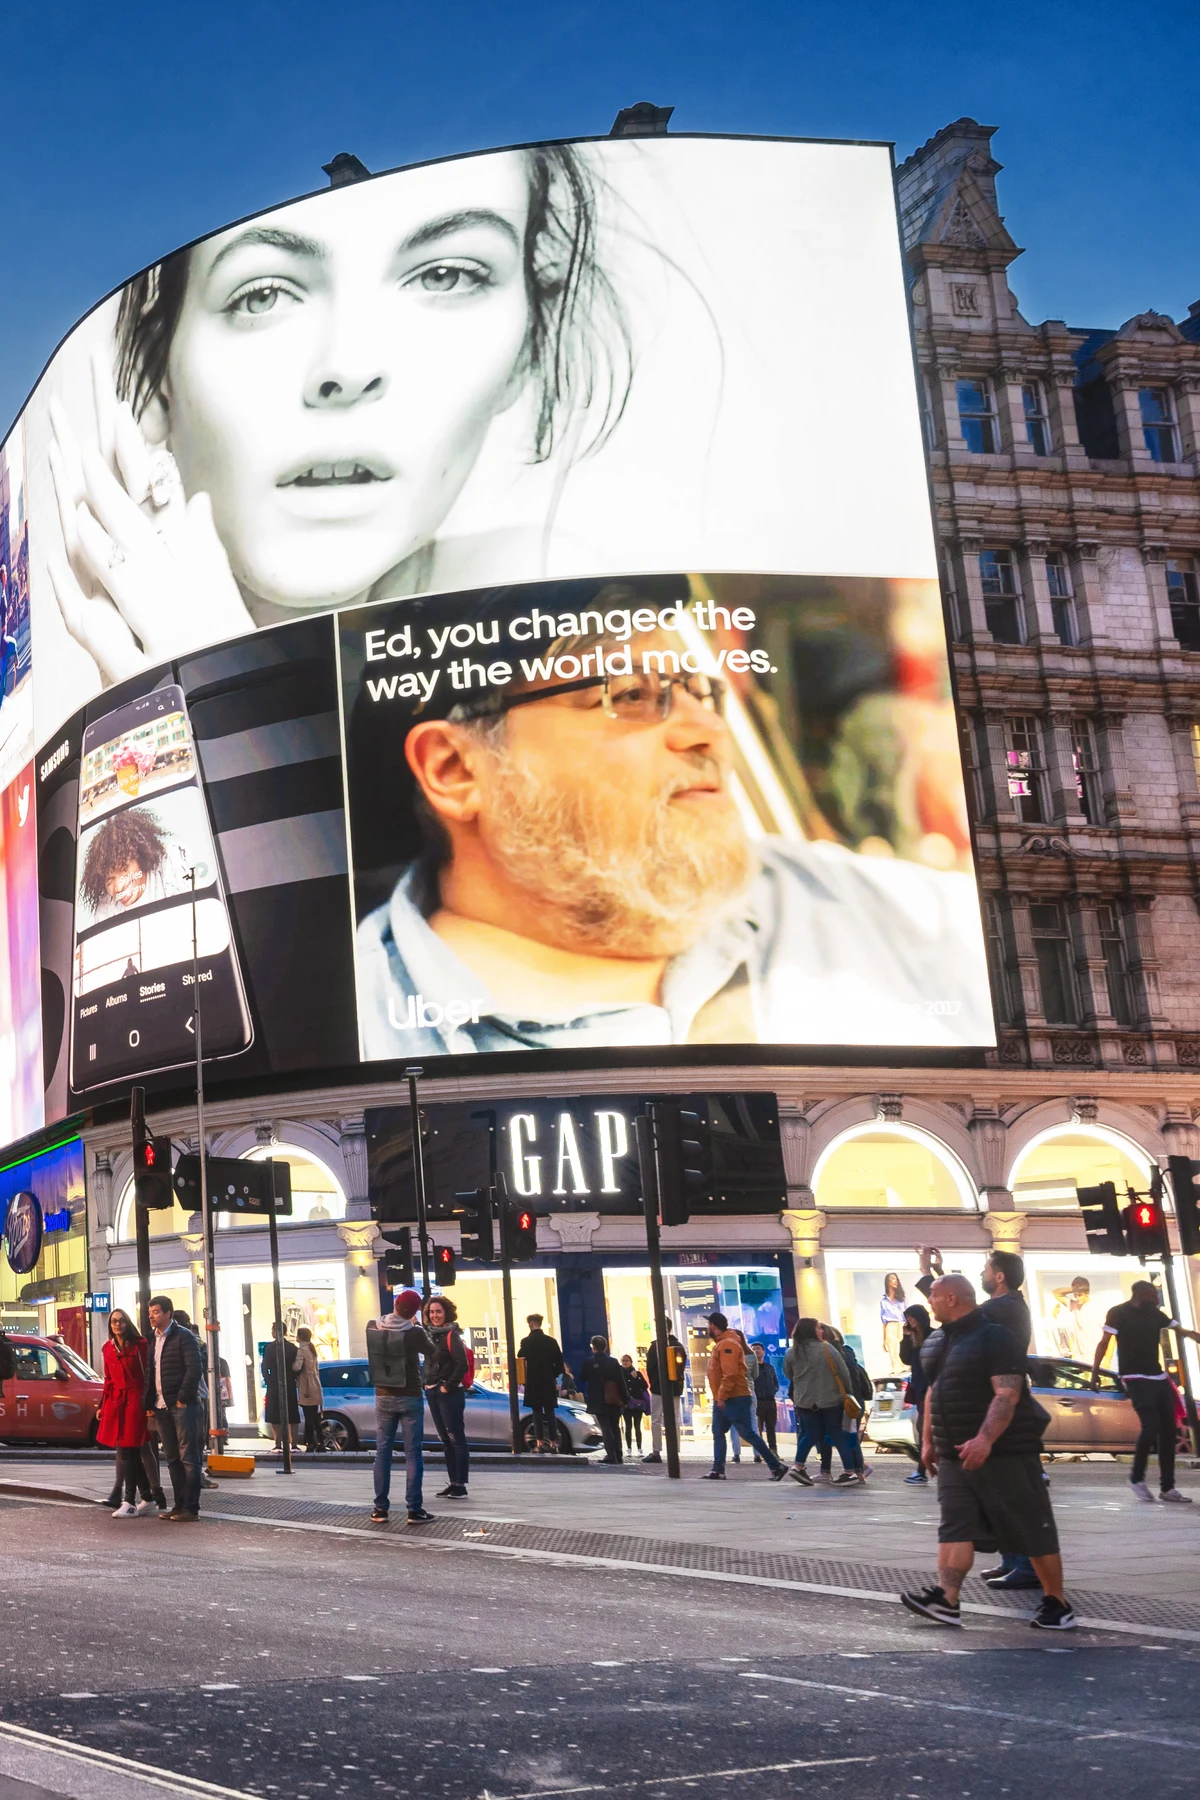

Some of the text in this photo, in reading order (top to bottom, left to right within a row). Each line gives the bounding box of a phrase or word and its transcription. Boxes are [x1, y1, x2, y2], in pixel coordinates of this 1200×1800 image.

[365, 600, 756, 662] Ed, you changed the
[366, 644, 778, 702] way the world moves.
[40, 739, 69, 782] SAMSUNG
[105, 993, 128, 1008] Albums
[139, 982, 166, 997] Stories
[80, 1004, 98, 1019] Pictures
[388, 994, 485, 1030] Uber
[509, 1111, 628, 1196] GAP
[95, 1297, 108, 1308] GAP
